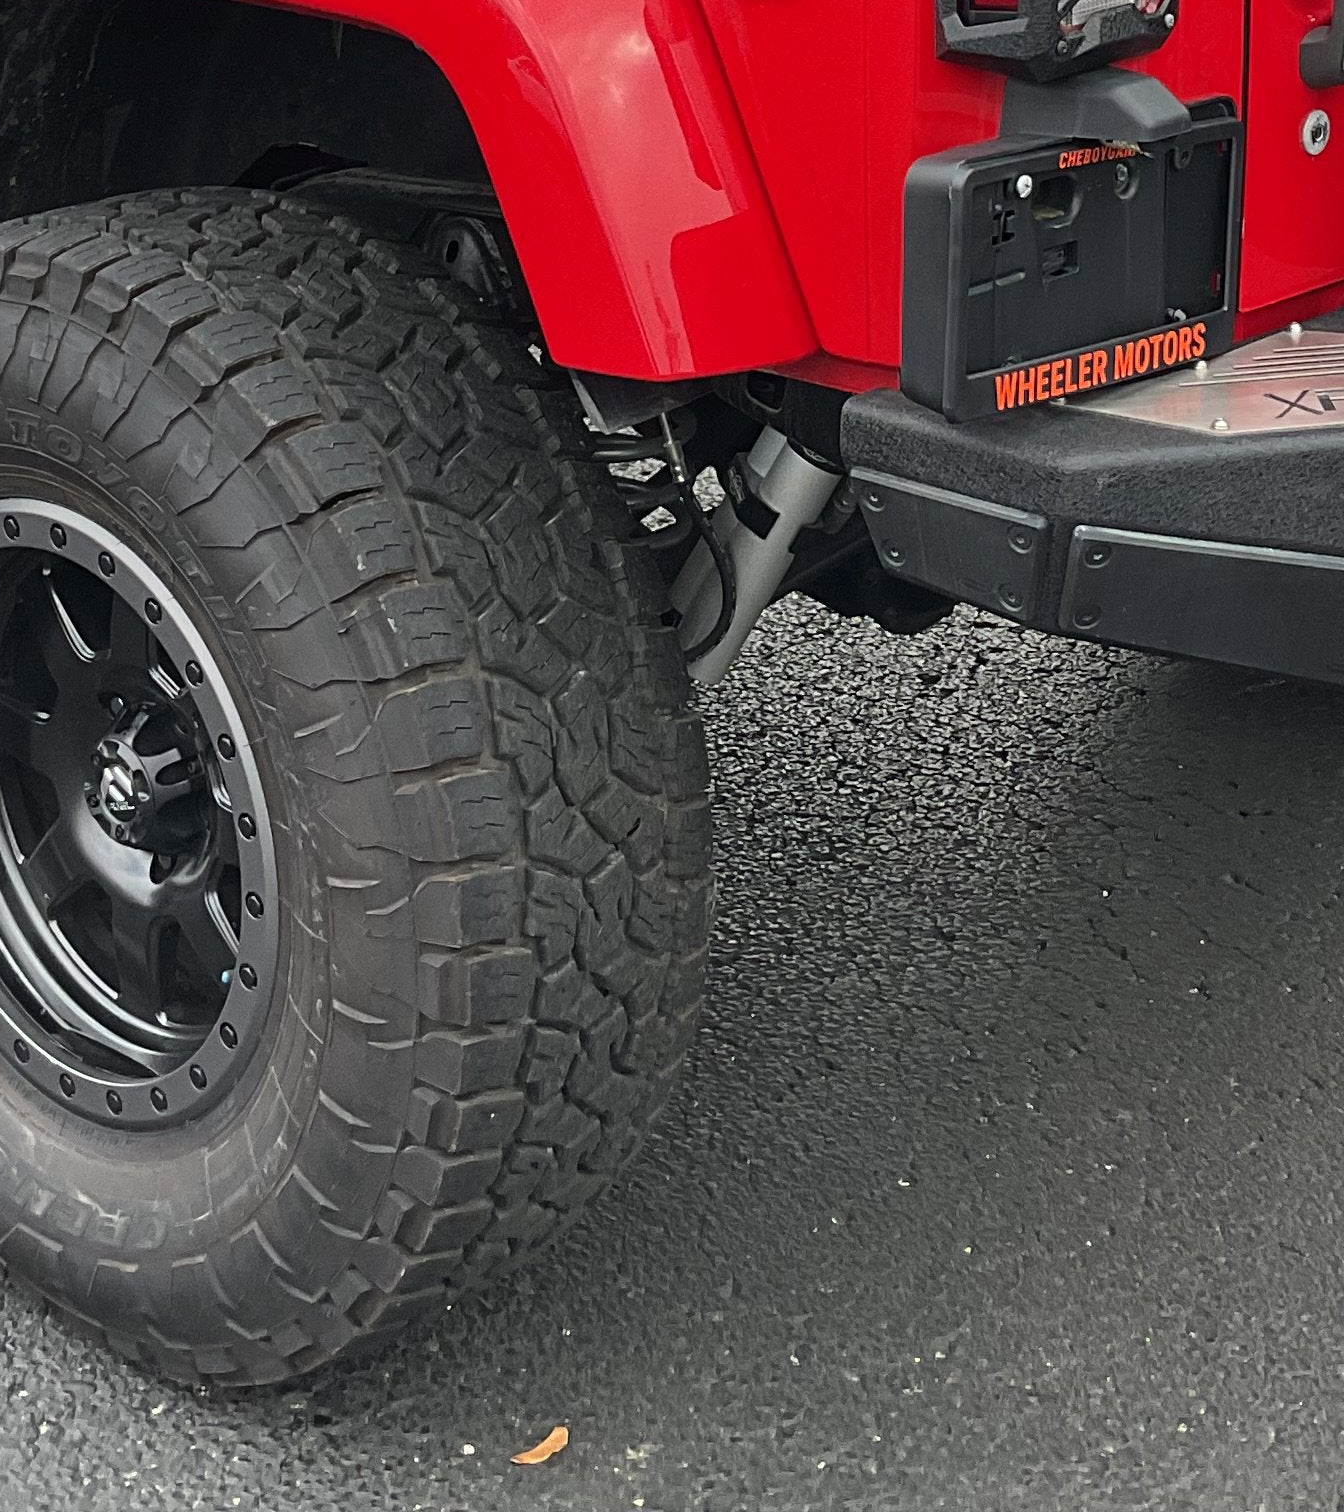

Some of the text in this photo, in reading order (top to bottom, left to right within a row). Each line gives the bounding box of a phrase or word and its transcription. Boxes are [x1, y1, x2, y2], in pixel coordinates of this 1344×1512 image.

[994, 322, 1207, 411] WHEELER MOTORS
[5, 407, 169, 536] TOYO
